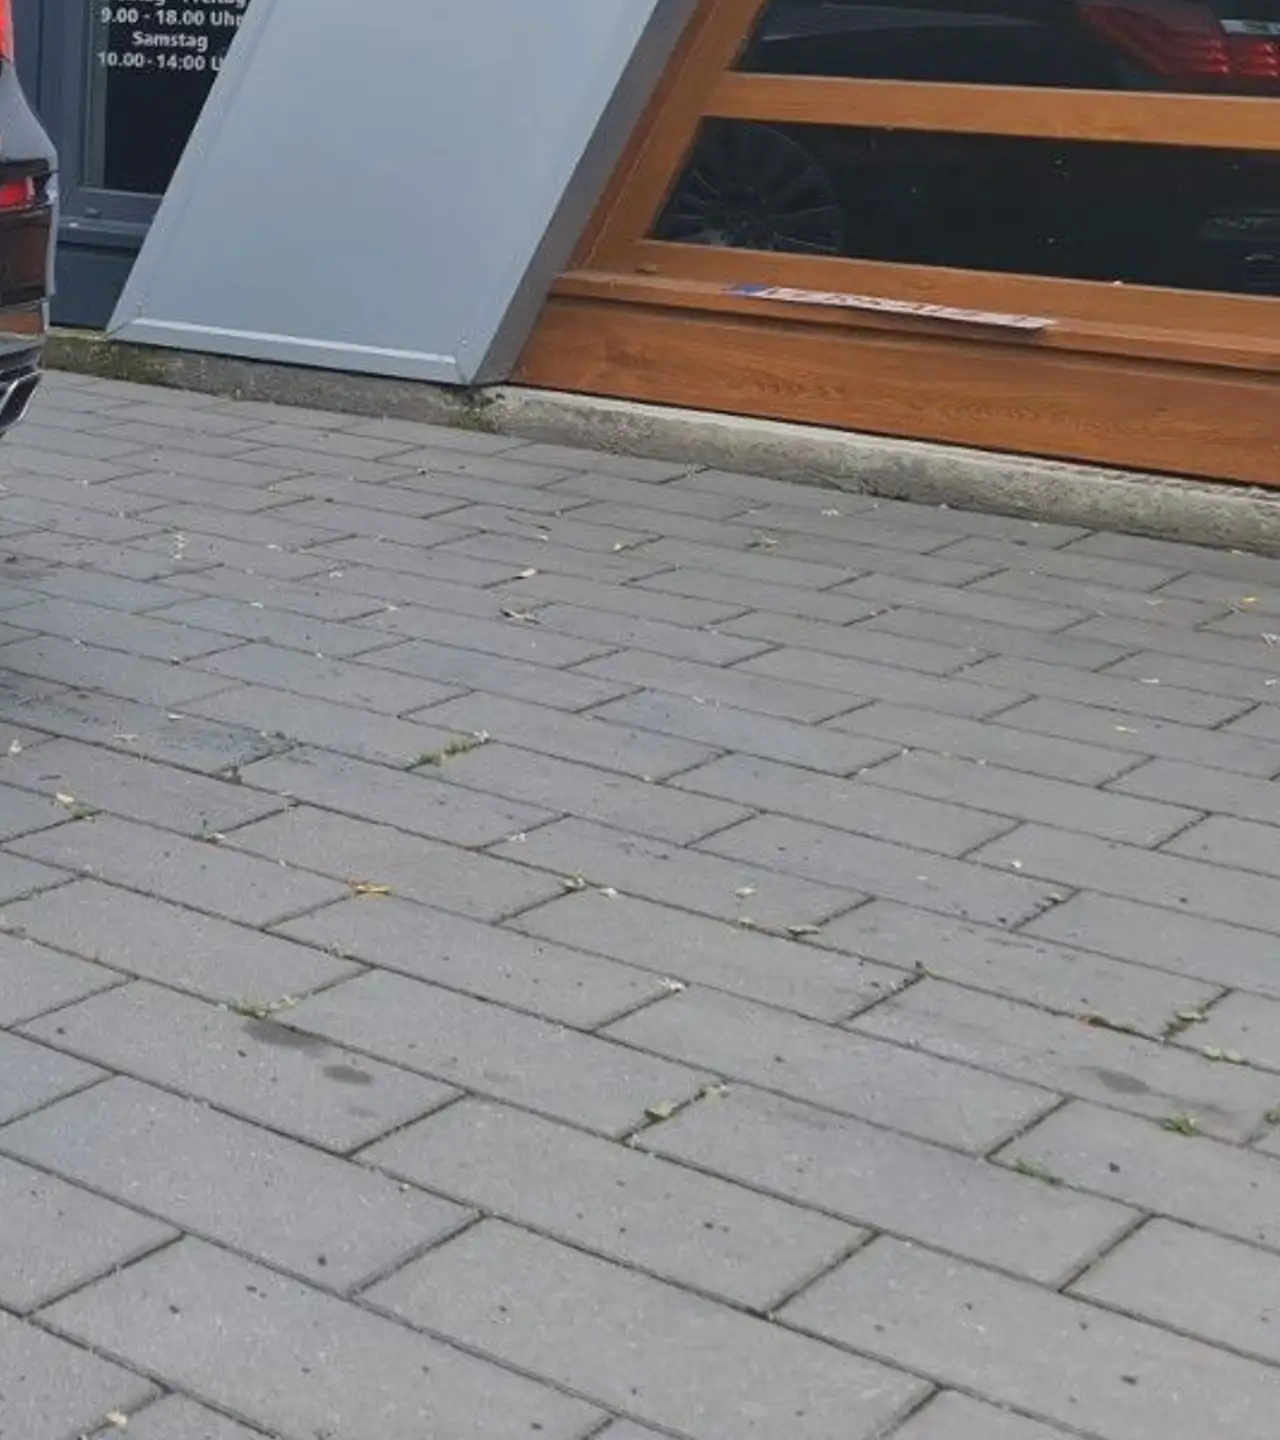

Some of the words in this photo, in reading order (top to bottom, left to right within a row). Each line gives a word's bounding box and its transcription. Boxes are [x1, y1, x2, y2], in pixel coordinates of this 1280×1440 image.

[101, 7, 139, 24] 9.00
[156, 9, 206, 26] 18.00
[131, 31, 209, 52] Samstag
